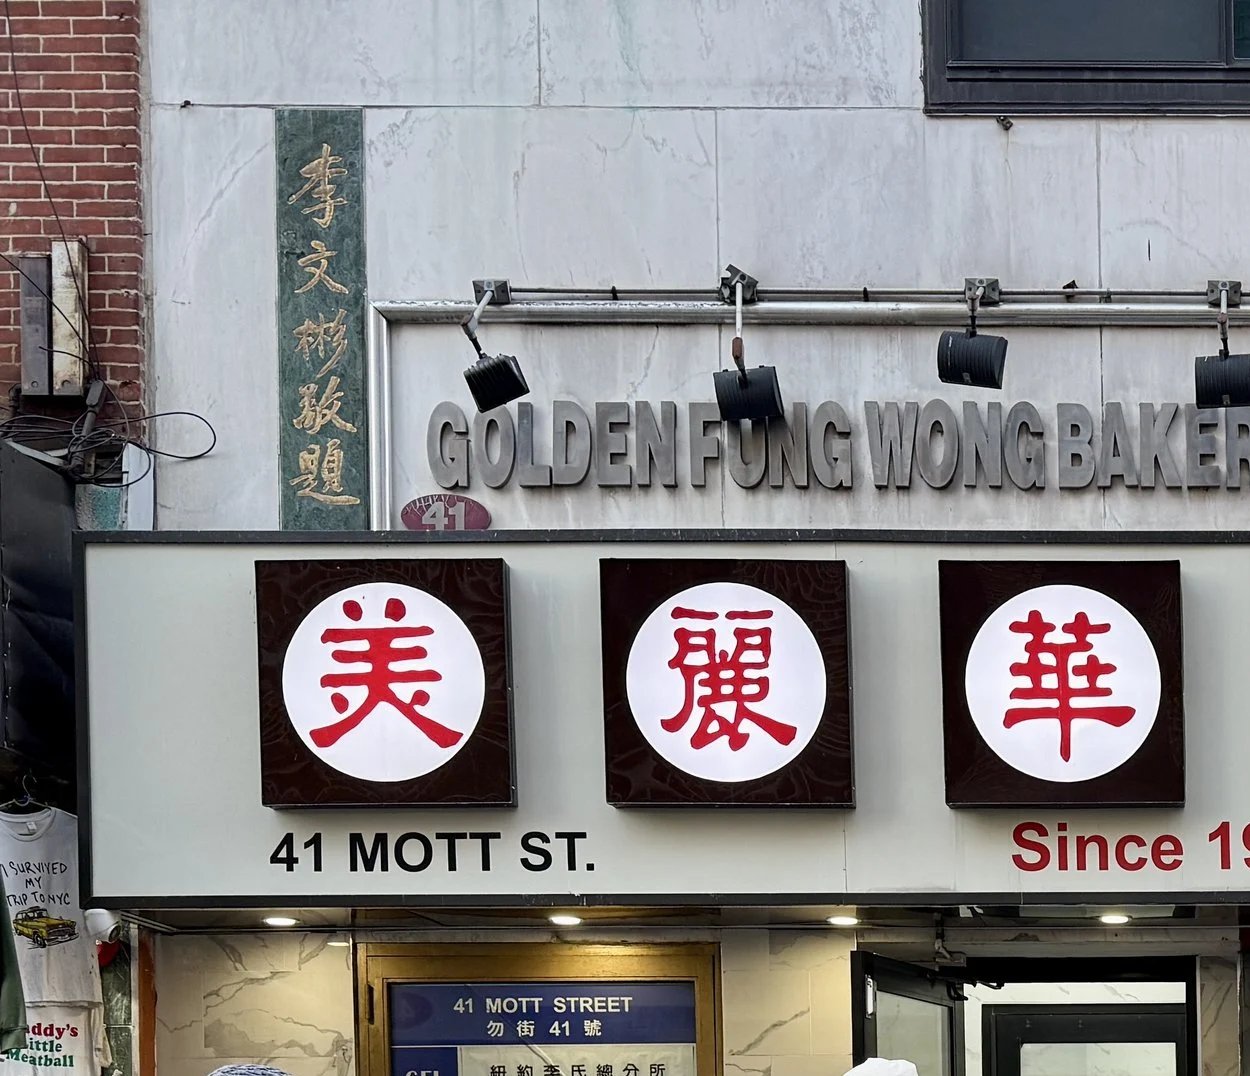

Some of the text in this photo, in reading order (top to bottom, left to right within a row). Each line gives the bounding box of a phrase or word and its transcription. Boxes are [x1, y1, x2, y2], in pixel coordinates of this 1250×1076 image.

[426, 400, 678, 489] GOLDEN
[690, 400, 853, 489] FUNG
[865, 399, 1047, 491] WONG
[422, 502, 466, 531] 41
[309, 598, 1137, 761] 美麗華
[268, 831, 596, 873] 41 MOTT ST.
[1012, 822, 1185, 872] Since
[9, 861, 68, 875] SURVIVED
[25, 876, 42, 890] MY
[7, 891, 71, 907] TRIP TO NYC
[453, 996, 633, 1014] 41 MOTT STREET
[25, 1022, 79, 1040] ddy's
[28, 1037, 63, 1052] ittle
